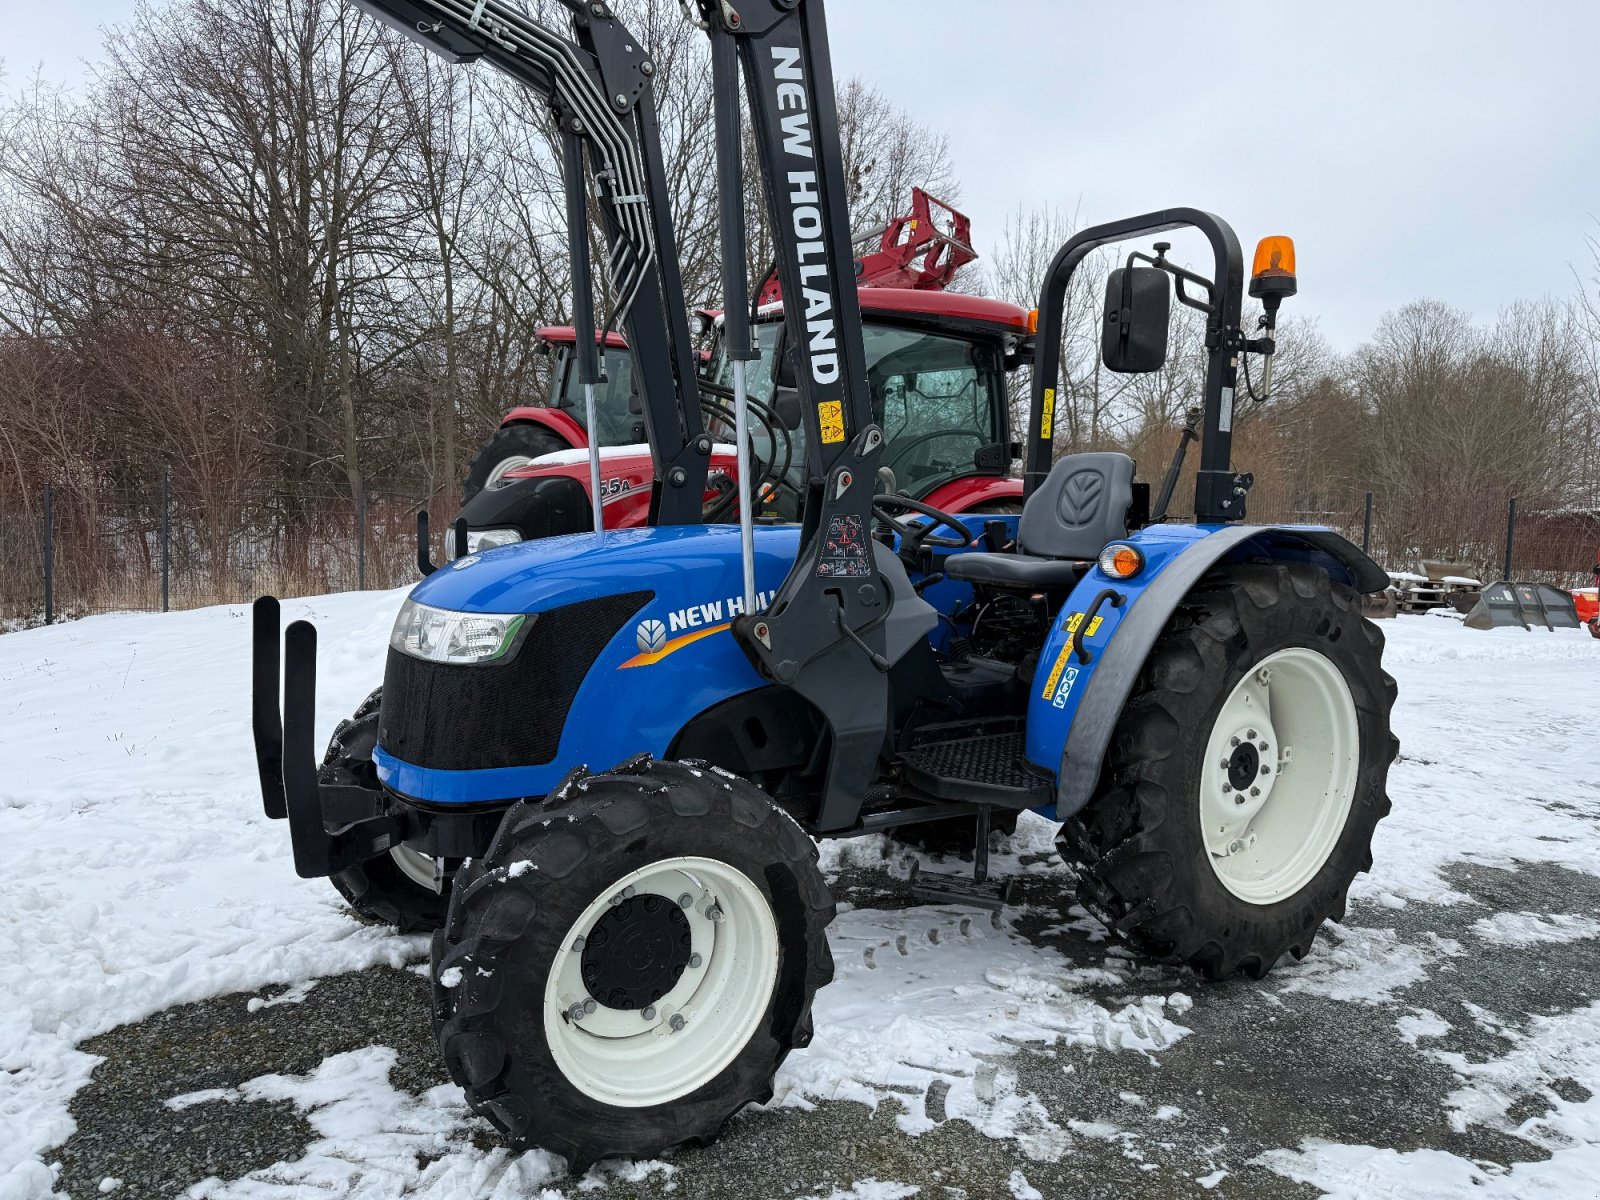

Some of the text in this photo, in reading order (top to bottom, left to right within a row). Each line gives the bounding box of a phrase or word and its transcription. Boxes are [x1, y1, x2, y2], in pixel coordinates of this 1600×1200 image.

[771, 46, 839, 385] NEW HOLLAND
[668, 600, 722, 632] NEW
